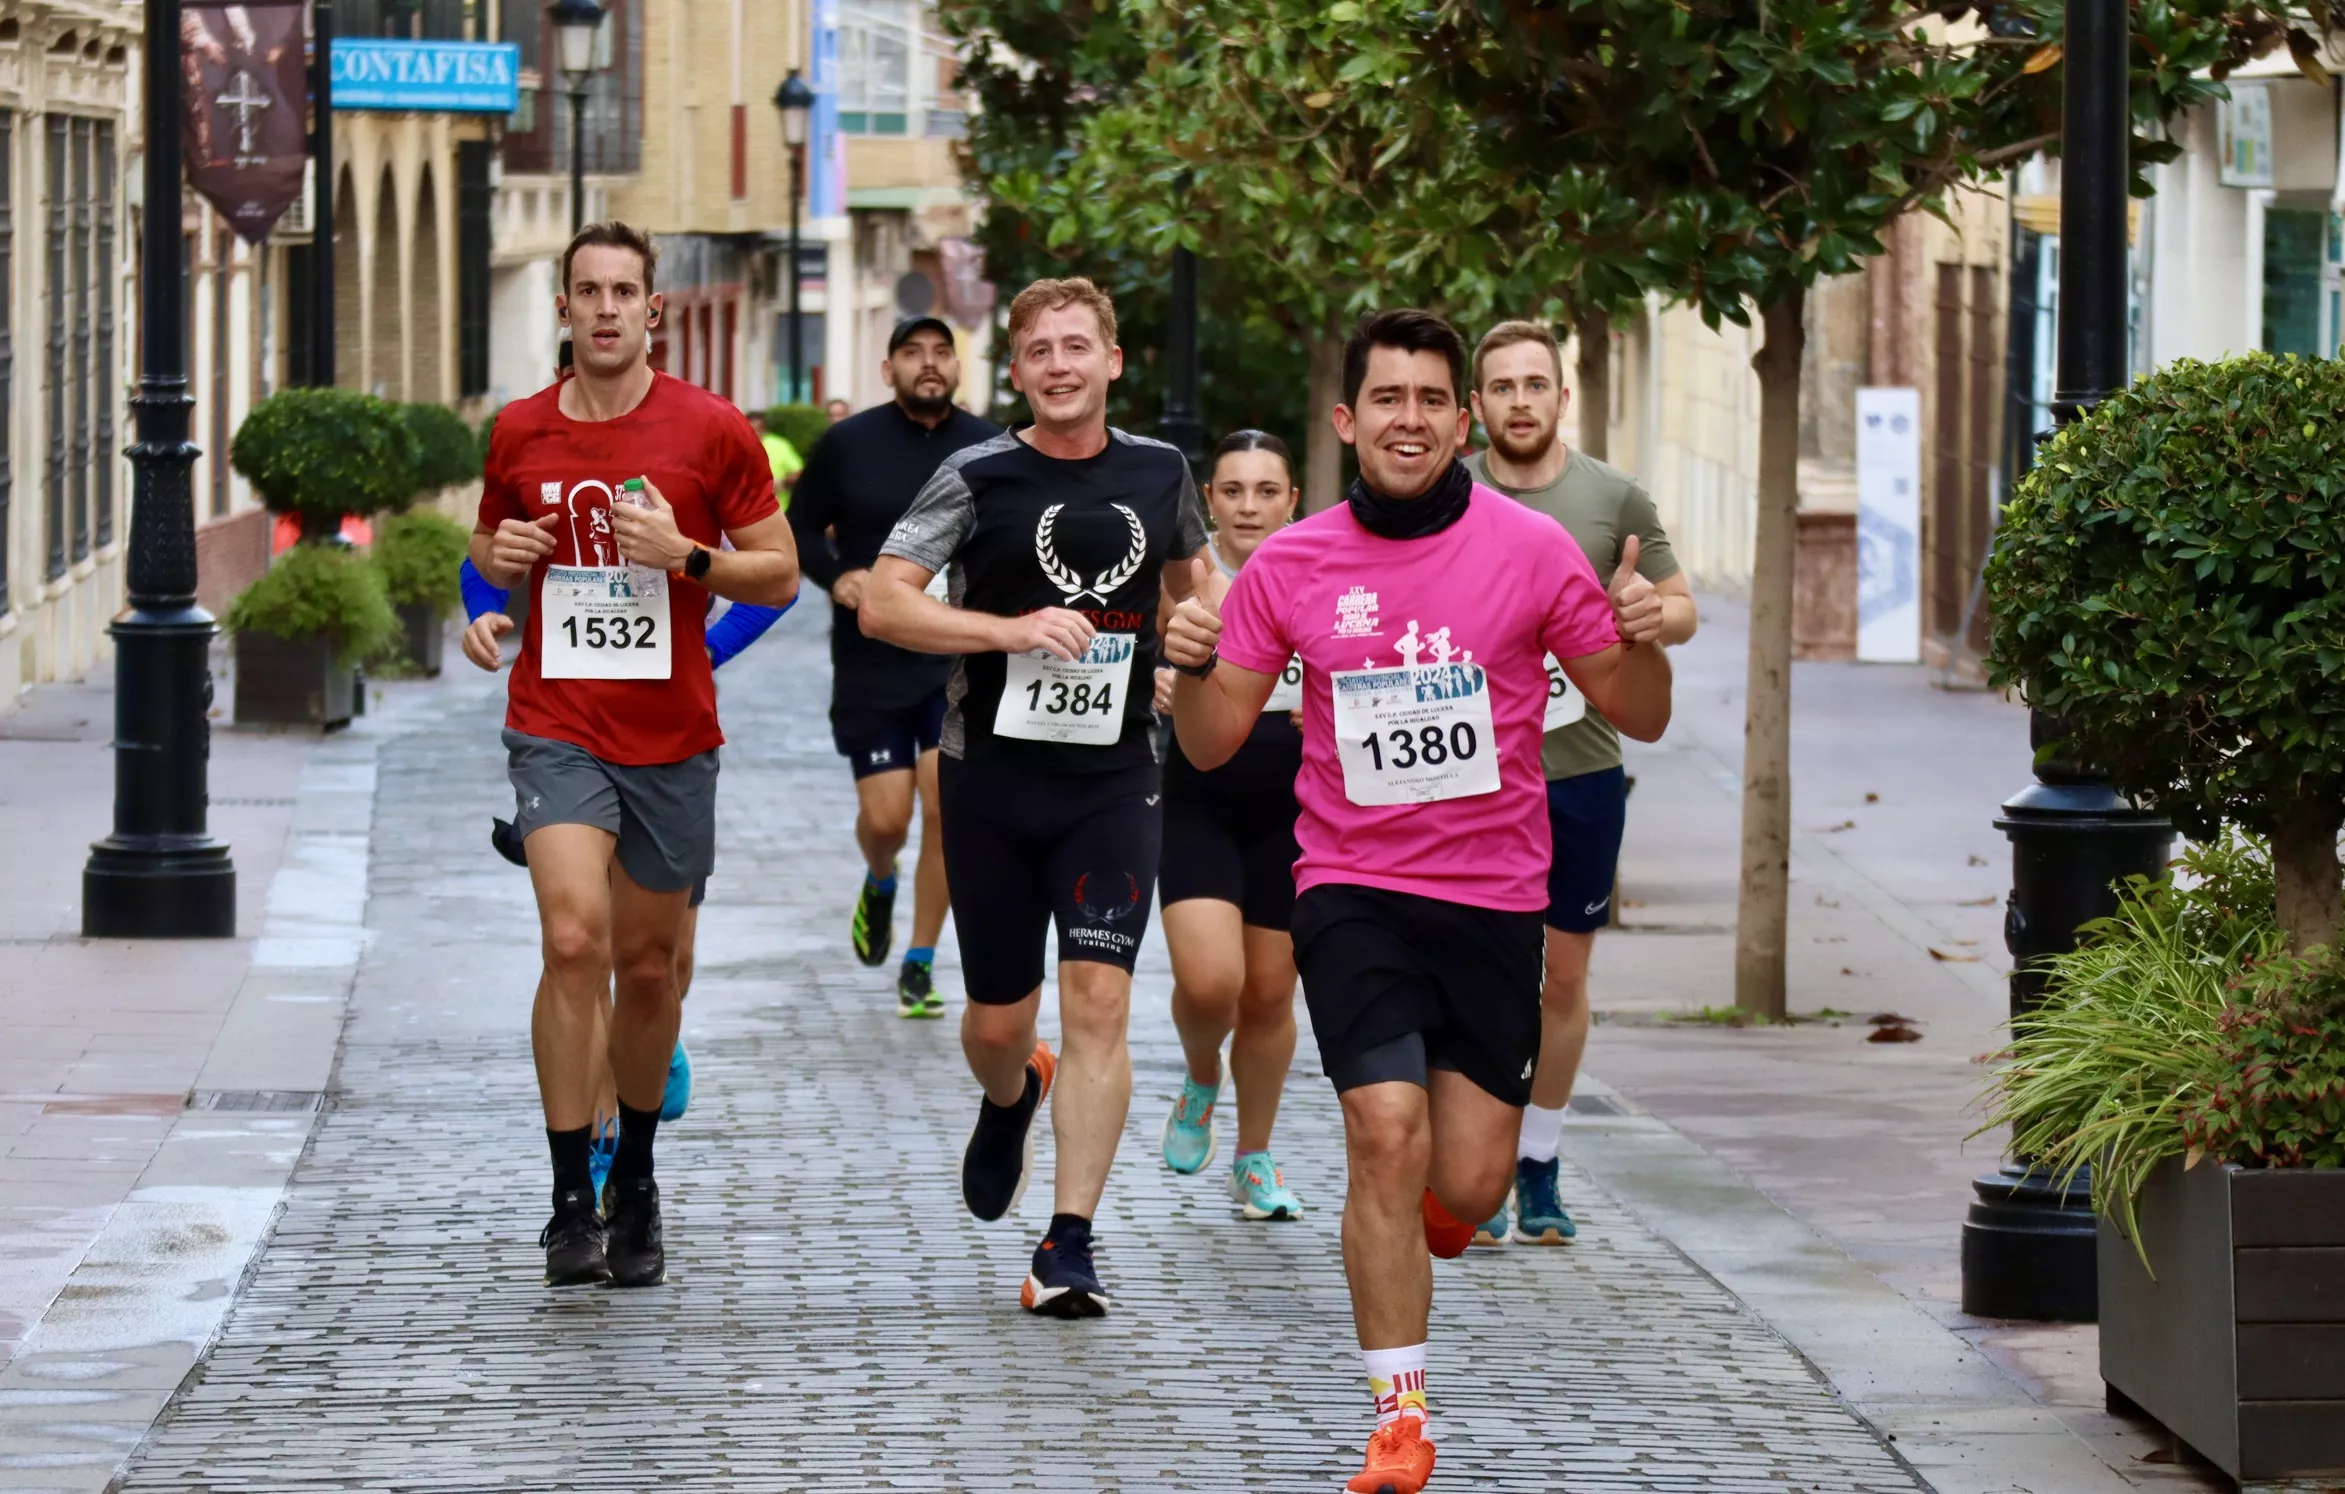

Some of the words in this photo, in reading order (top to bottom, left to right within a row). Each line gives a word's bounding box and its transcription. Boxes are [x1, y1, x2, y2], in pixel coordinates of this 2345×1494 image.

[331, 50, 511, 84] CONTAFISA
[562, 616, 656, 649] 1532
[1104, 610, 1143, 629] GYM
[1026, 679, 1112, 716] 1384
[1362, 721, 1477, 771] 1380
[1069, 928, 1111, 941] HERMES
[1111, 933, 1135, 947] GYM
[1078, 938, 1122, 953] Training
